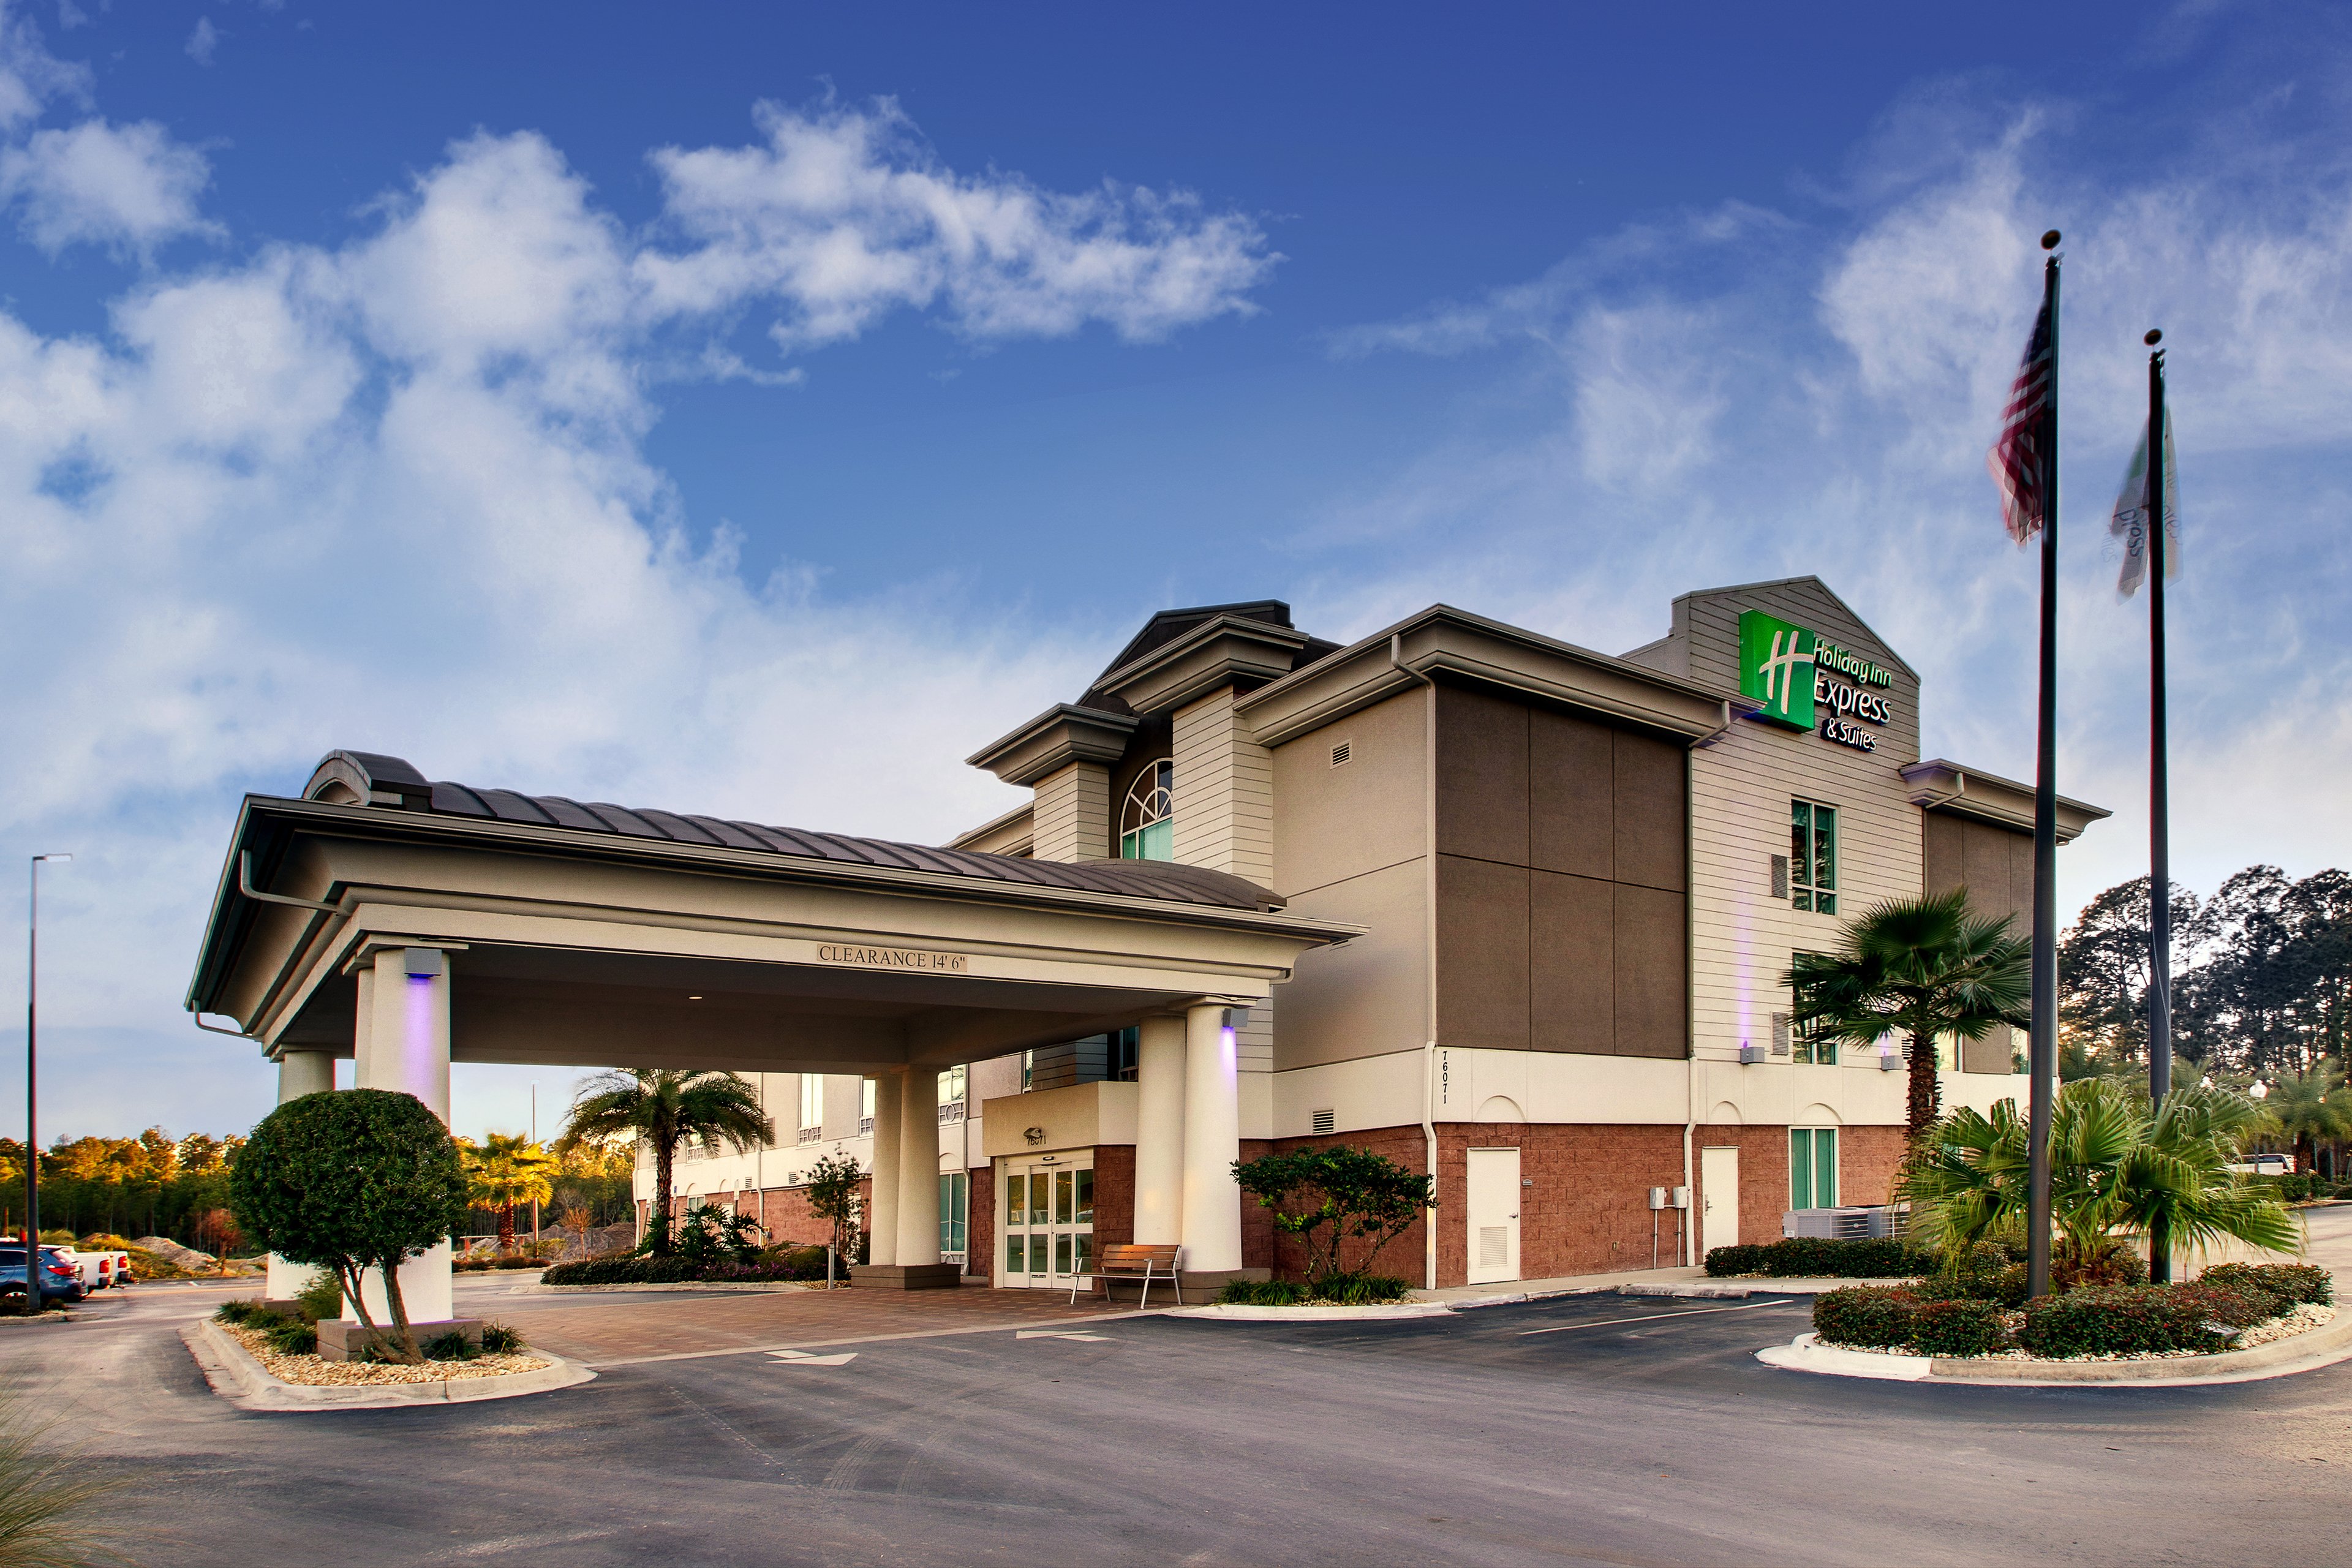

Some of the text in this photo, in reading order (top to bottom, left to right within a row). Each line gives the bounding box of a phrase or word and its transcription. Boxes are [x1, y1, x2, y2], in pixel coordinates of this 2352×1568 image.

[1814, 637, 1891, 687] Holiday Inn
[1814, 668, 1891, 724] Express
[1826, 717, 1877, 751] & Suites
[820, 946, 926, 967] CLEARANCE
[932, 954, 948, 968] 14'
